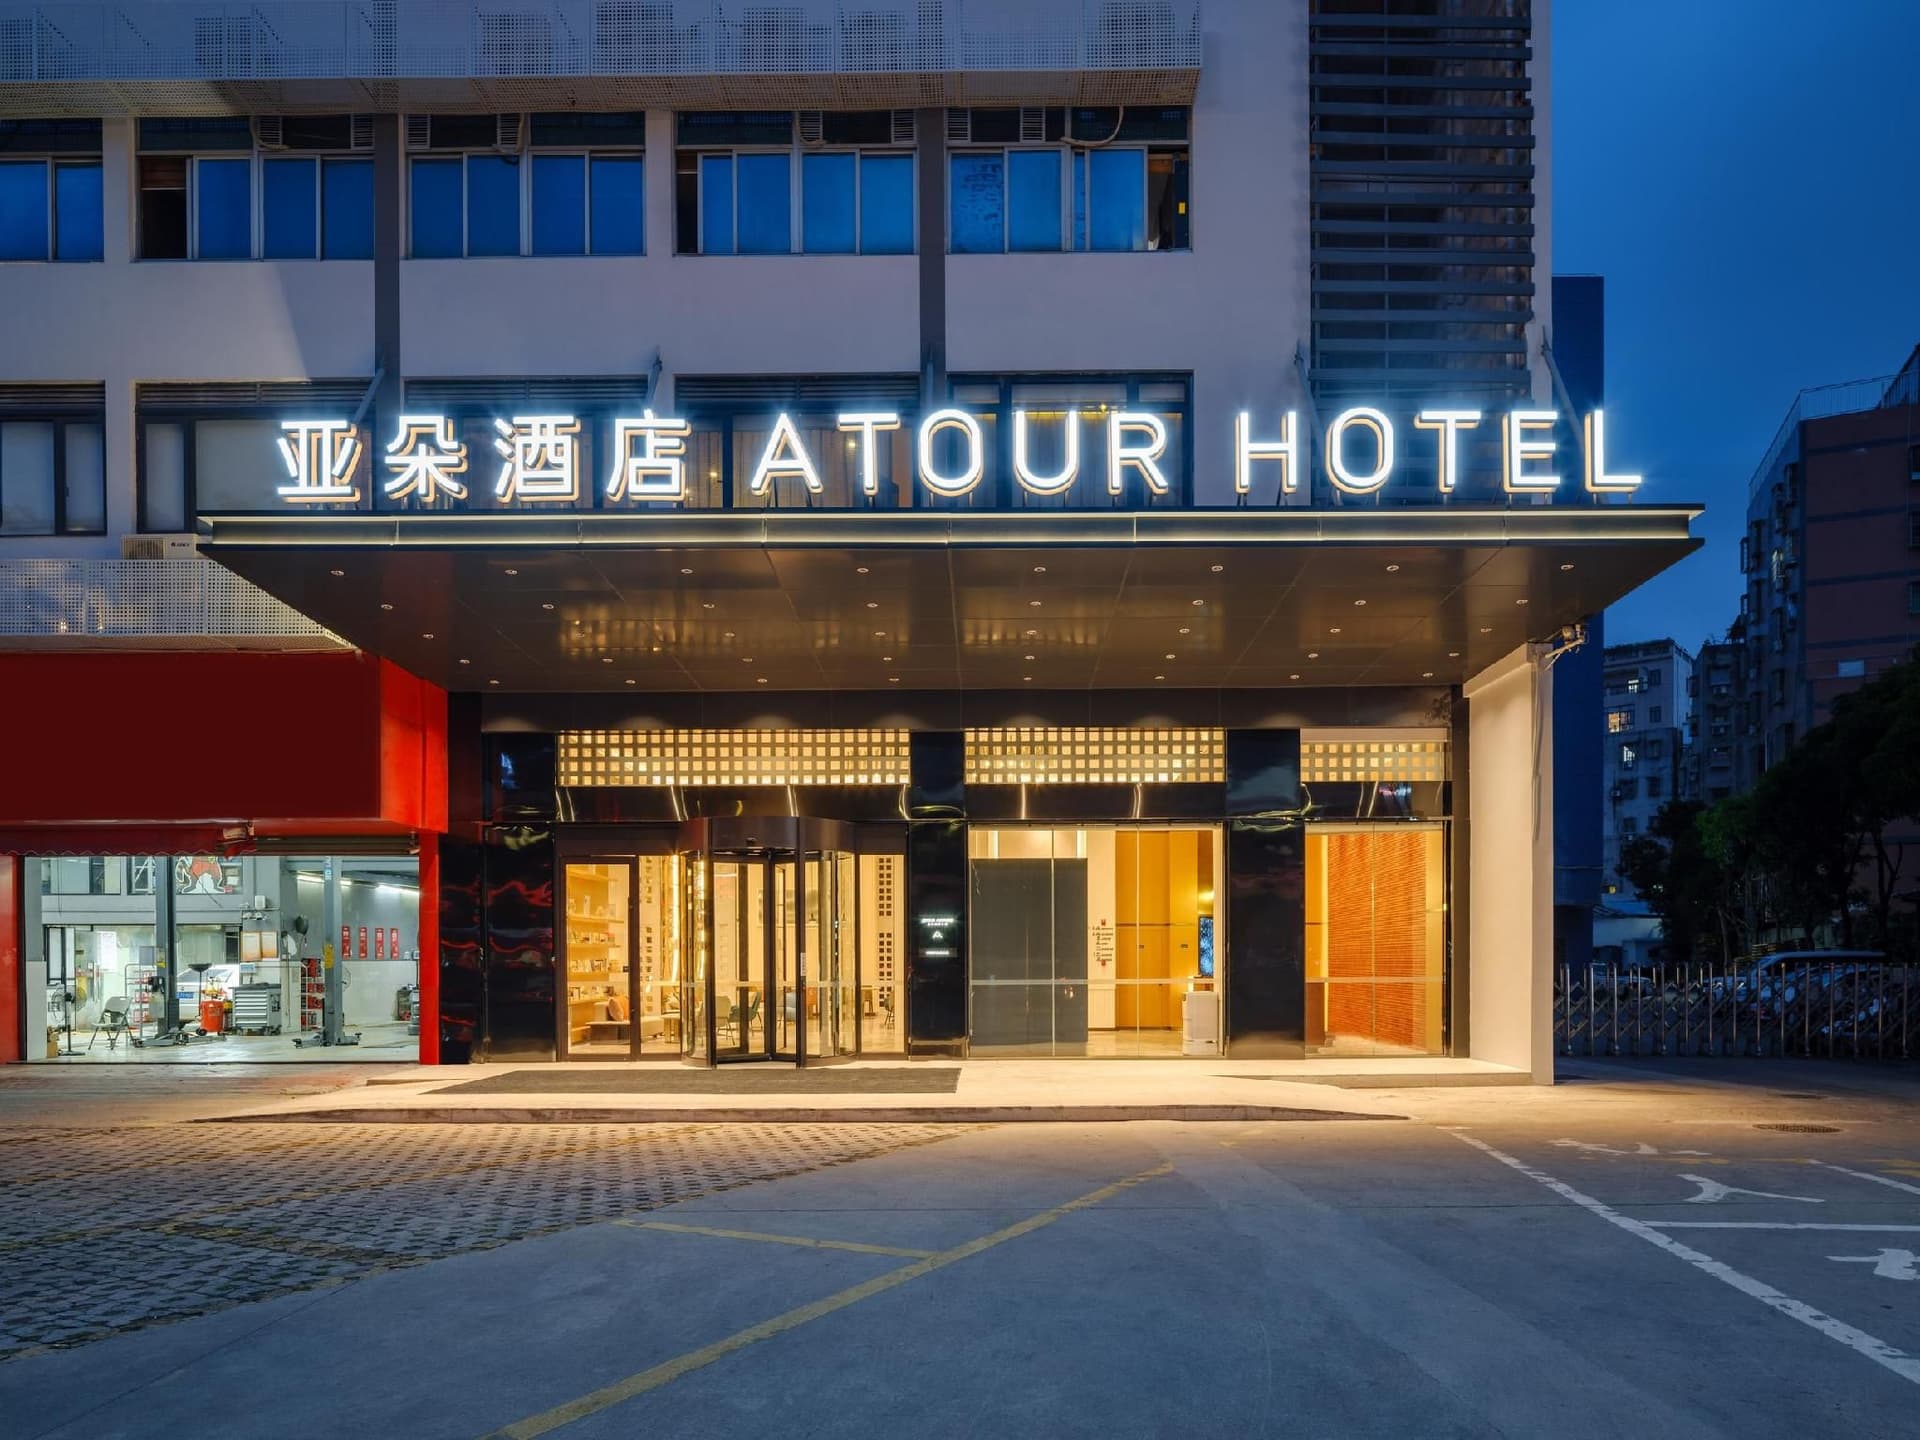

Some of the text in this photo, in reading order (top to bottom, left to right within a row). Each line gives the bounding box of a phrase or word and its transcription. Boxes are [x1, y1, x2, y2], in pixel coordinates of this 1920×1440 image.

[276, 409, 691, 501] 亚朵酒店
[751, 406, 1643, 496] ATOUR HOTEL
